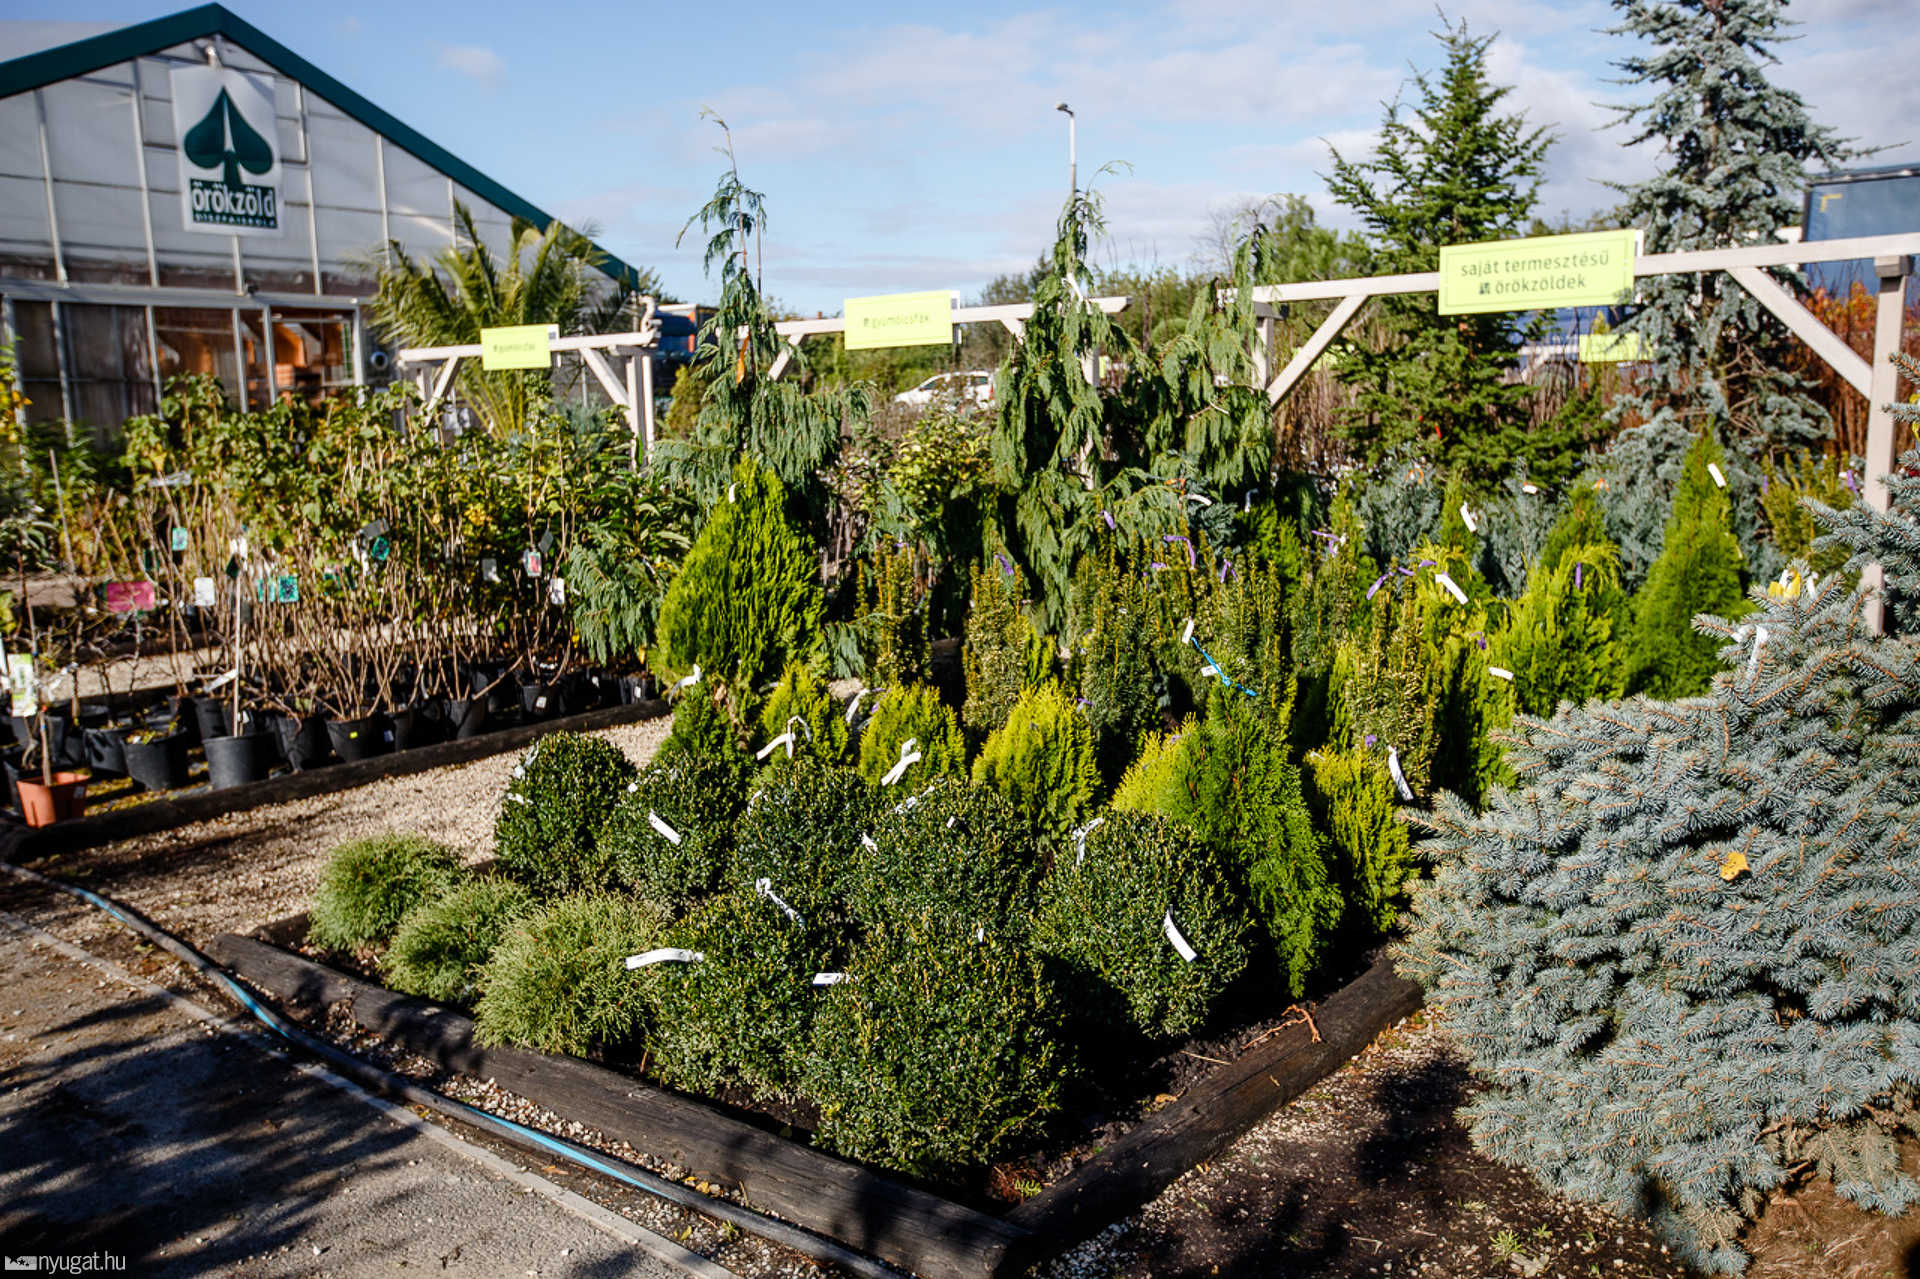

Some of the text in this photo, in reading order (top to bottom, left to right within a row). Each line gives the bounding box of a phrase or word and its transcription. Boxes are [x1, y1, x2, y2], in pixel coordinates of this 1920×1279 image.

[192, 181, 275, 218] örökzöld
[1460, 249, 1610, 278] saját termesztésű
[1495, 273, 1587, 296] örökzöldek
